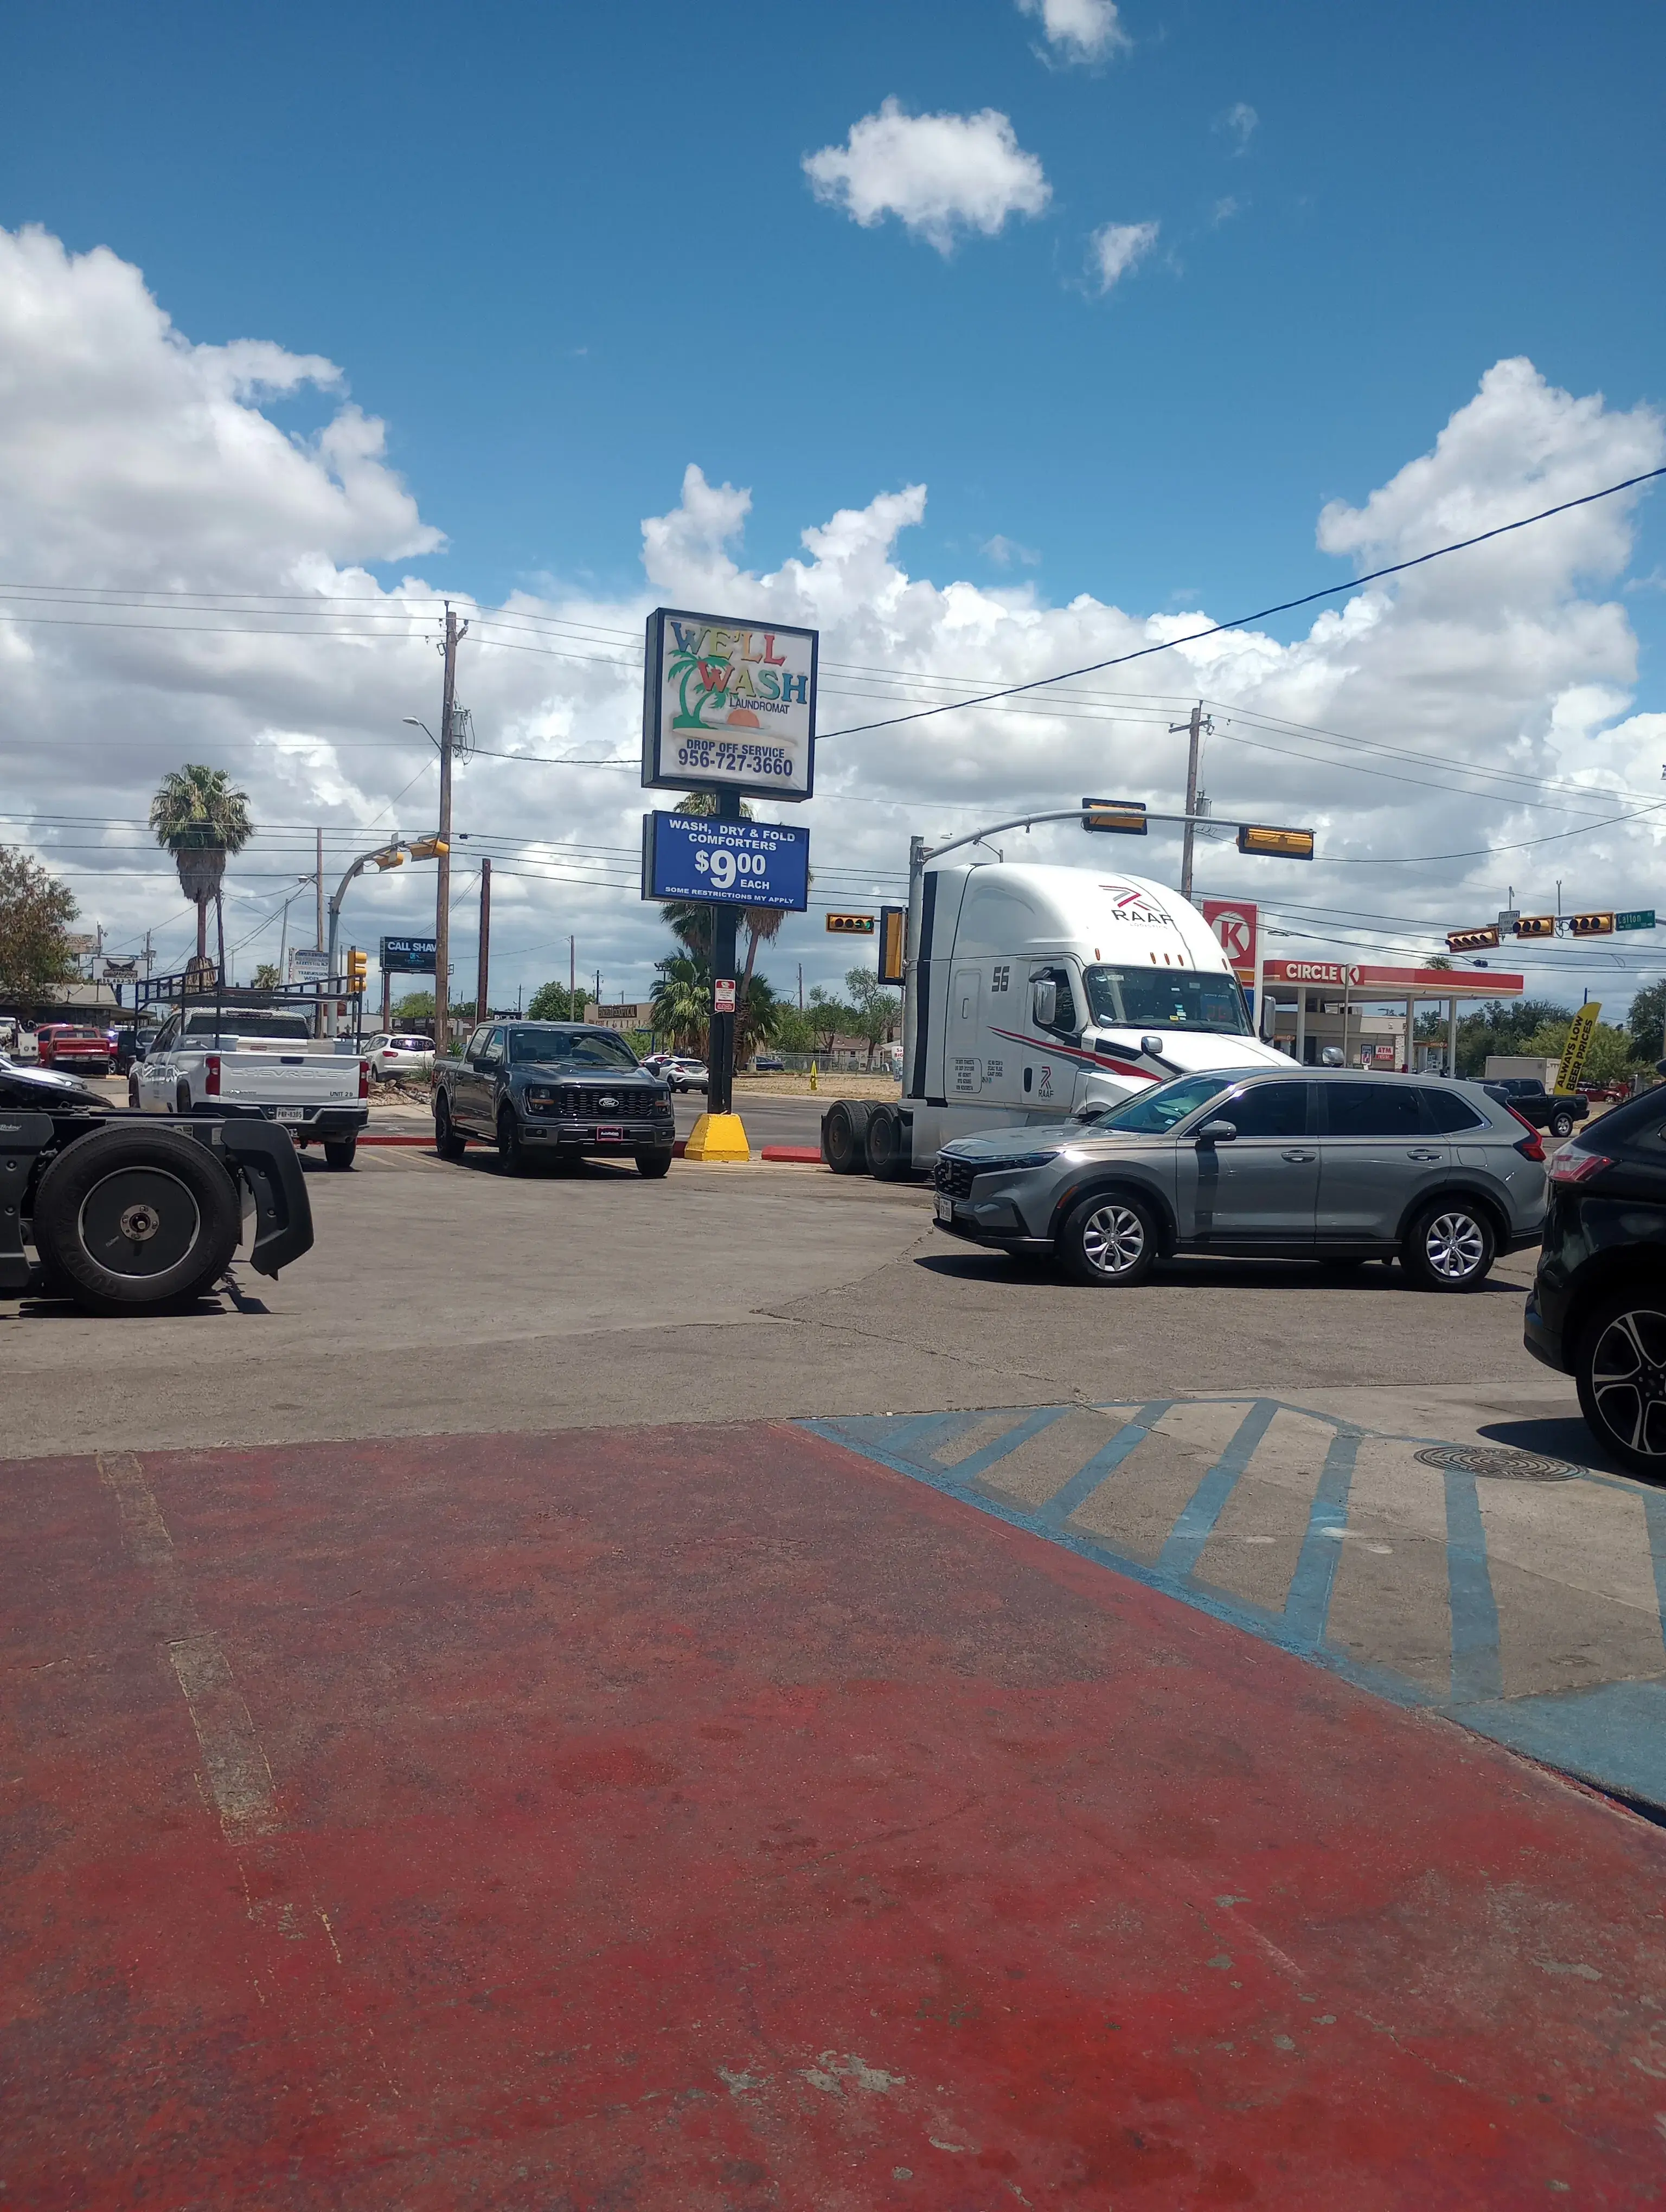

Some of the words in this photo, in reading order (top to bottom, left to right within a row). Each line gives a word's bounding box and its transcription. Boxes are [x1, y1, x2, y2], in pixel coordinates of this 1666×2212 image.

[671, 622, 787, 666] WE'LL
[697, 661, 808, 704] WASH
[729, 695, 790, 714] LAUNDROMAT
[687, 739, 715, 751] DROP
[719, 743, 738, 754] OFF
[741, 745, 785, 758] SERVICE
[678, 749, 793, 776] 956-727-3660
[669, 819, 712, 834] WASH,
[720, 825, 746, 836] DRY
[750, 829, 759, 838] &
[763, 830, 796, 842] FOLD
[688, 833, 777, 851] COMFORTERS
[740, 879, 770, 890] EACH
[665, 886, 690, 895] SOME
[691, 889, 752, 900] RESTRICTIONS
[768, 896, 794, 904] APPLY
[1111, 909, 1174, 925] RAAF
[1618, 914, 1641, 924] Calton
[388, 942, 411, 951] CALL
[991, 966, 1010, 992] 56
[1286, 963, 1337, 981] CIRCLE
[1557, 1042, 1577, 1088] ALWAYS
[1570, 1015, 1584, 1041] LOW
[1565, 1060, 1582, 1091] BEER
[1576, 1018, 1593, 1060] PRICES
[230, 1069, 352, 1079] CHEVROLET
[1039, 1089, 1054, 1097] RAAF
